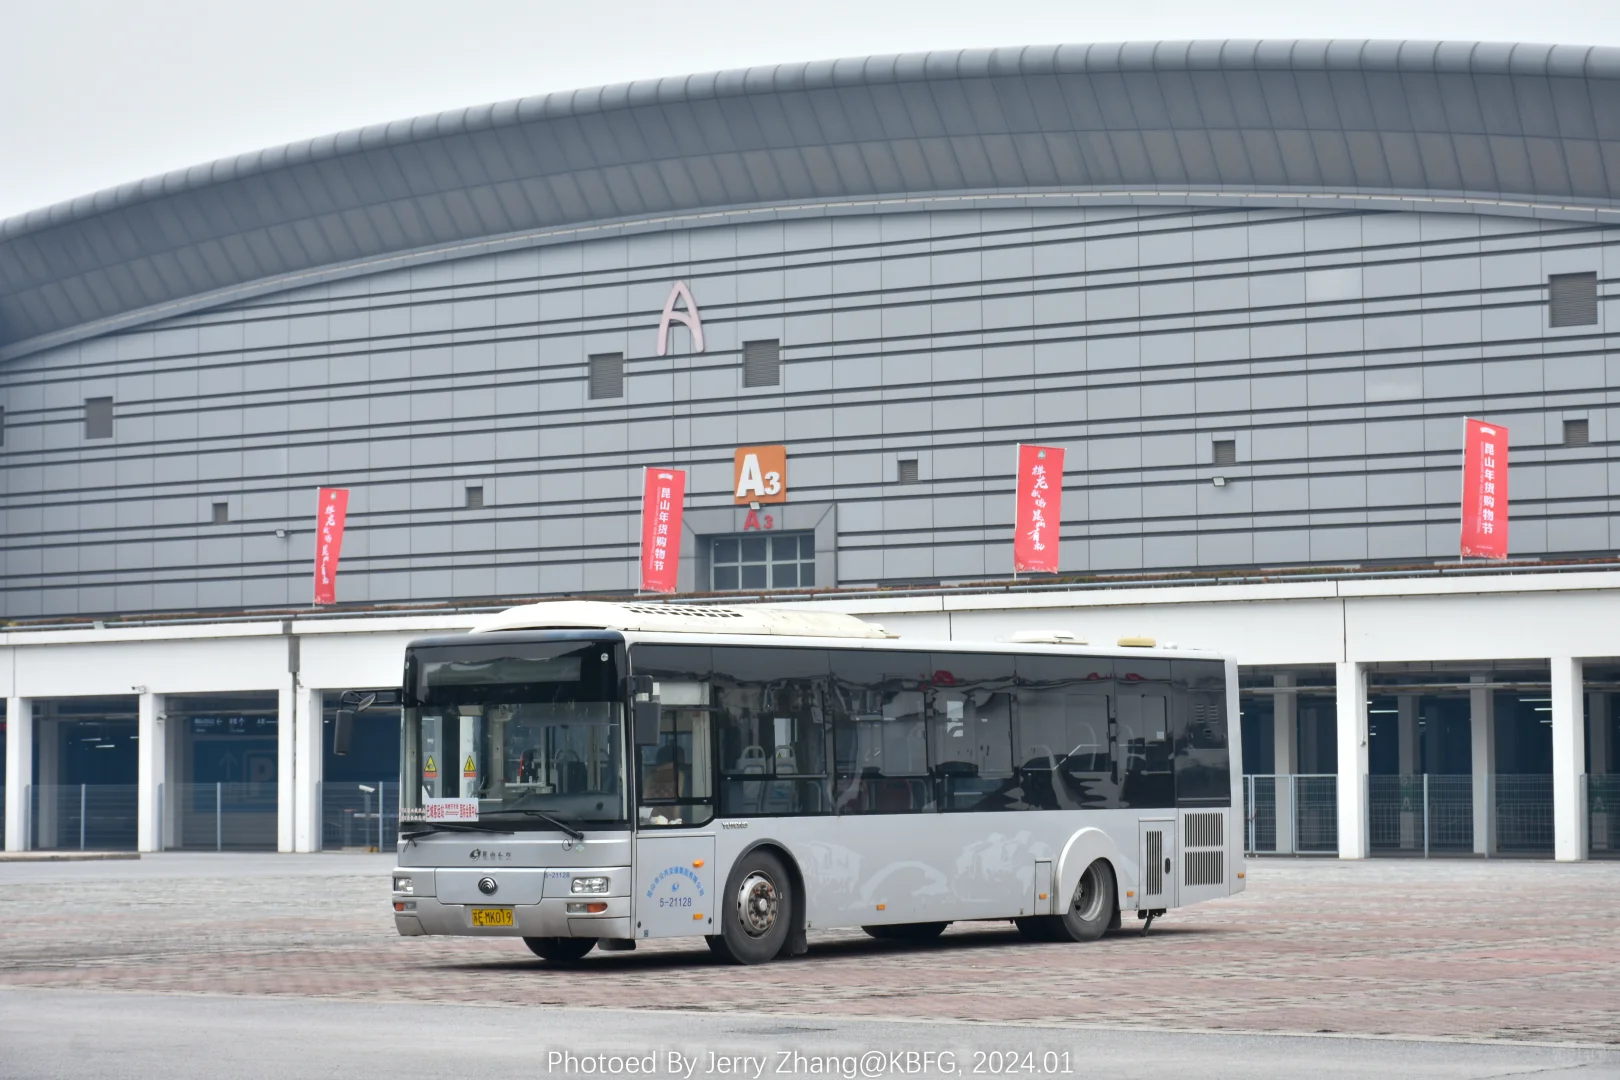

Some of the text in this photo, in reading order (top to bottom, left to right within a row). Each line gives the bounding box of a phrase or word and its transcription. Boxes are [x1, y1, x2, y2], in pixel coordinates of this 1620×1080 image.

[657, 280, 704, 356] A
[736, 453, 781, 497] A3
[1481, 442, 1495, 535] 昆山年货购物节
[653, 487, 671, 572] 昆山年货购物节
[659, 897, 692, 908] 5-21128
